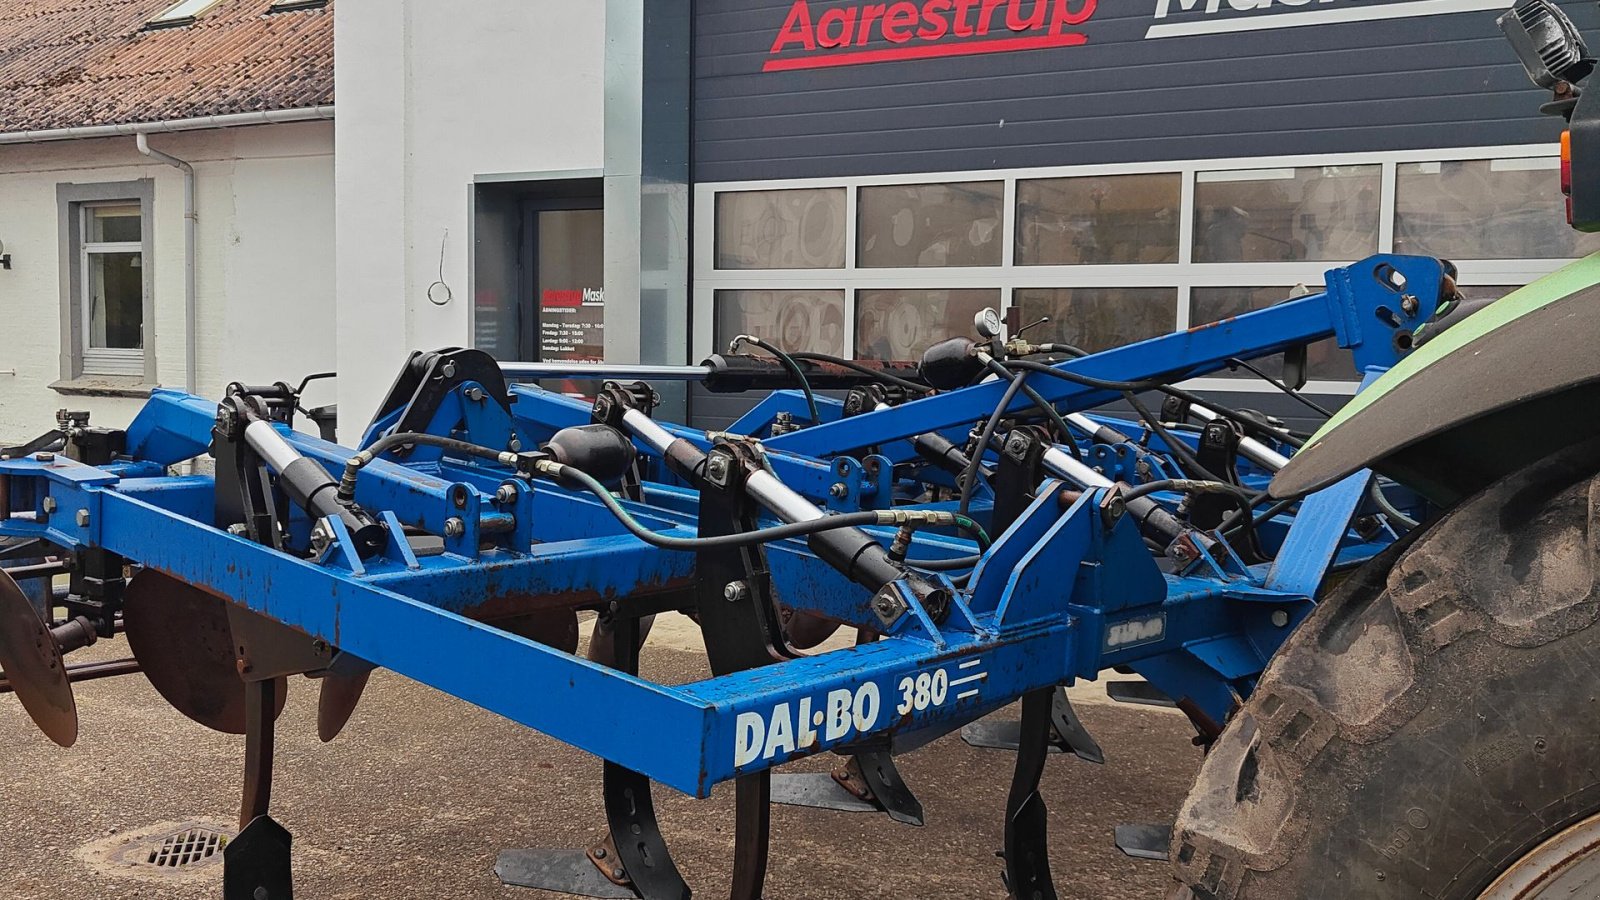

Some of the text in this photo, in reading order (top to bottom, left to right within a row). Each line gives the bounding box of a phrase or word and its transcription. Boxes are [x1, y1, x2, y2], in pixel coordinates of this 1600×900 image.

[770, 0, 1097, 53] Aarestrup
[582, 287, 604, 302] Mask
[897, 668, 948, 716] 380
